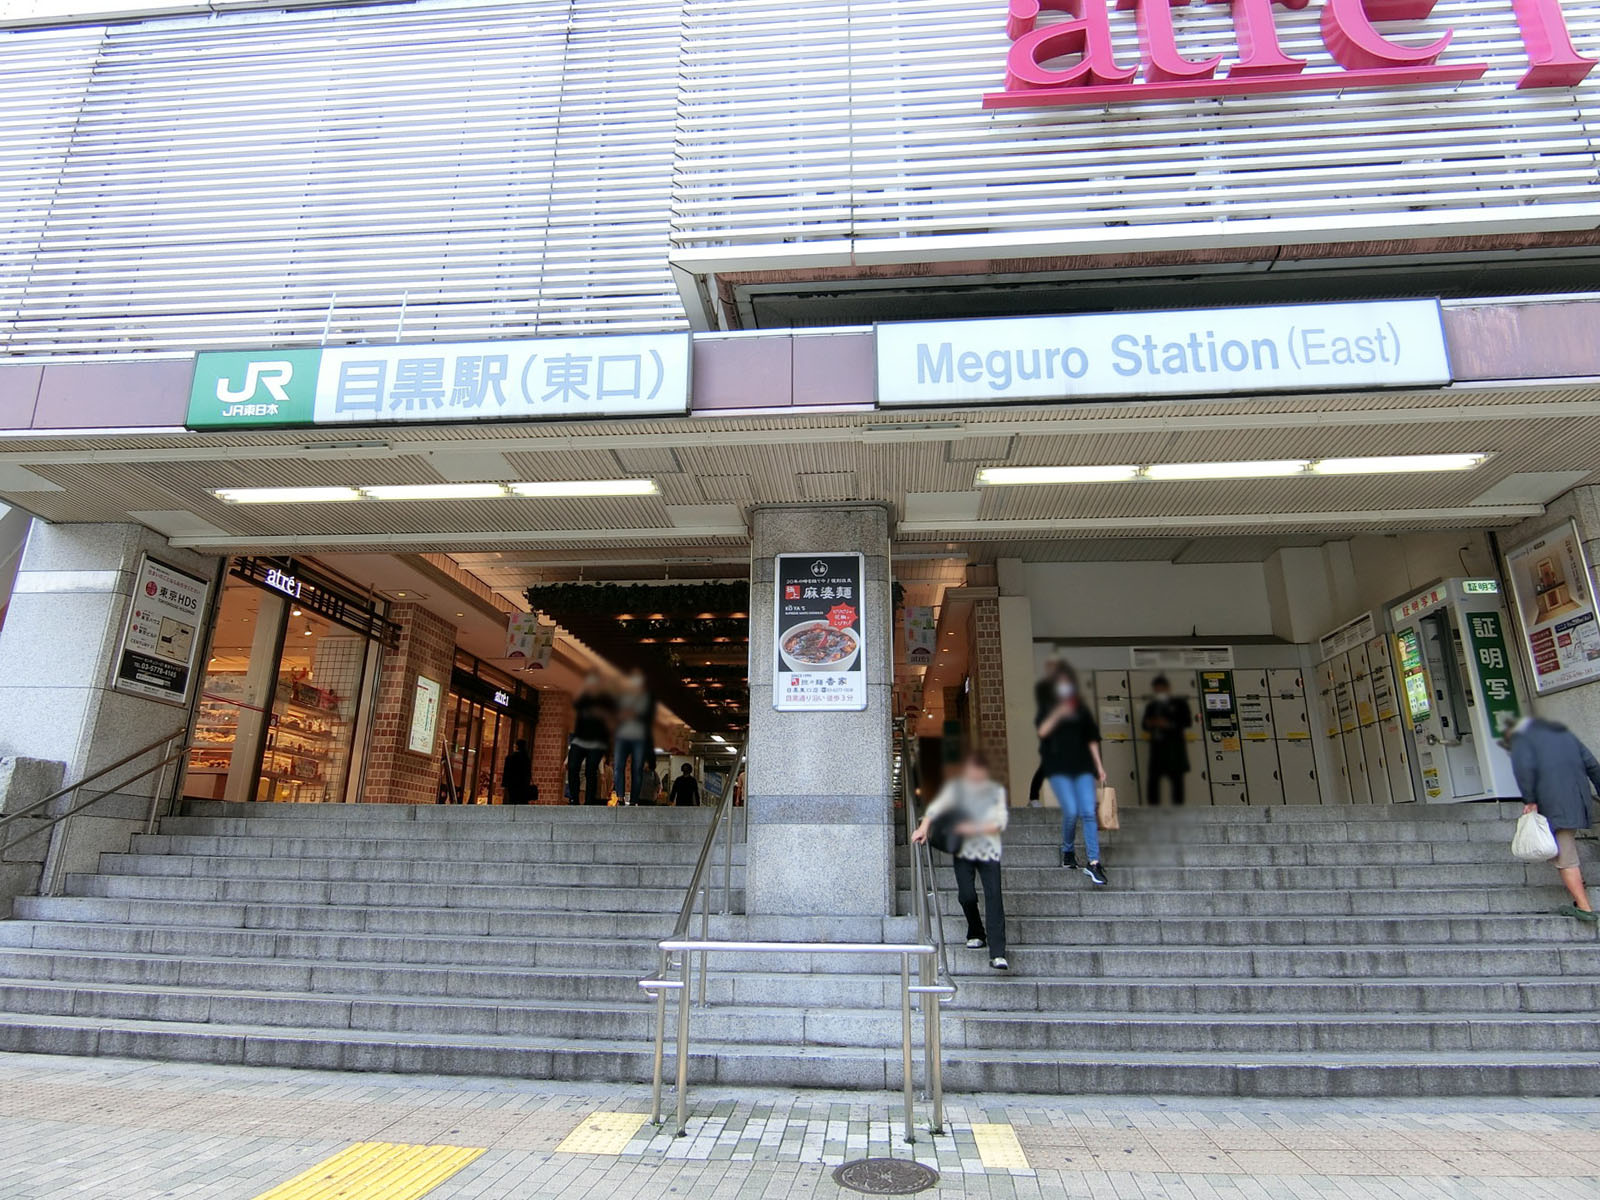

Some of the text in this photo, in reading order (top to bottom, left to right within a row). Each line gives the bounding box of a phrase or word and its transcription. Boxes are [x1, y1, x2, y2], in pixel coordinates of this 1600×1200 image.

[915, 320, 1402, 391] Meguro Station (East)
[215, 360, 293, 404] JR
[334, 348, 665, 414] 目黒駅（東口）
[222, 402, 280, 417] JR東日本
[159, 585, 198, 610] 東京HDS
[1401, 591, 1440, 618] 証明写真
